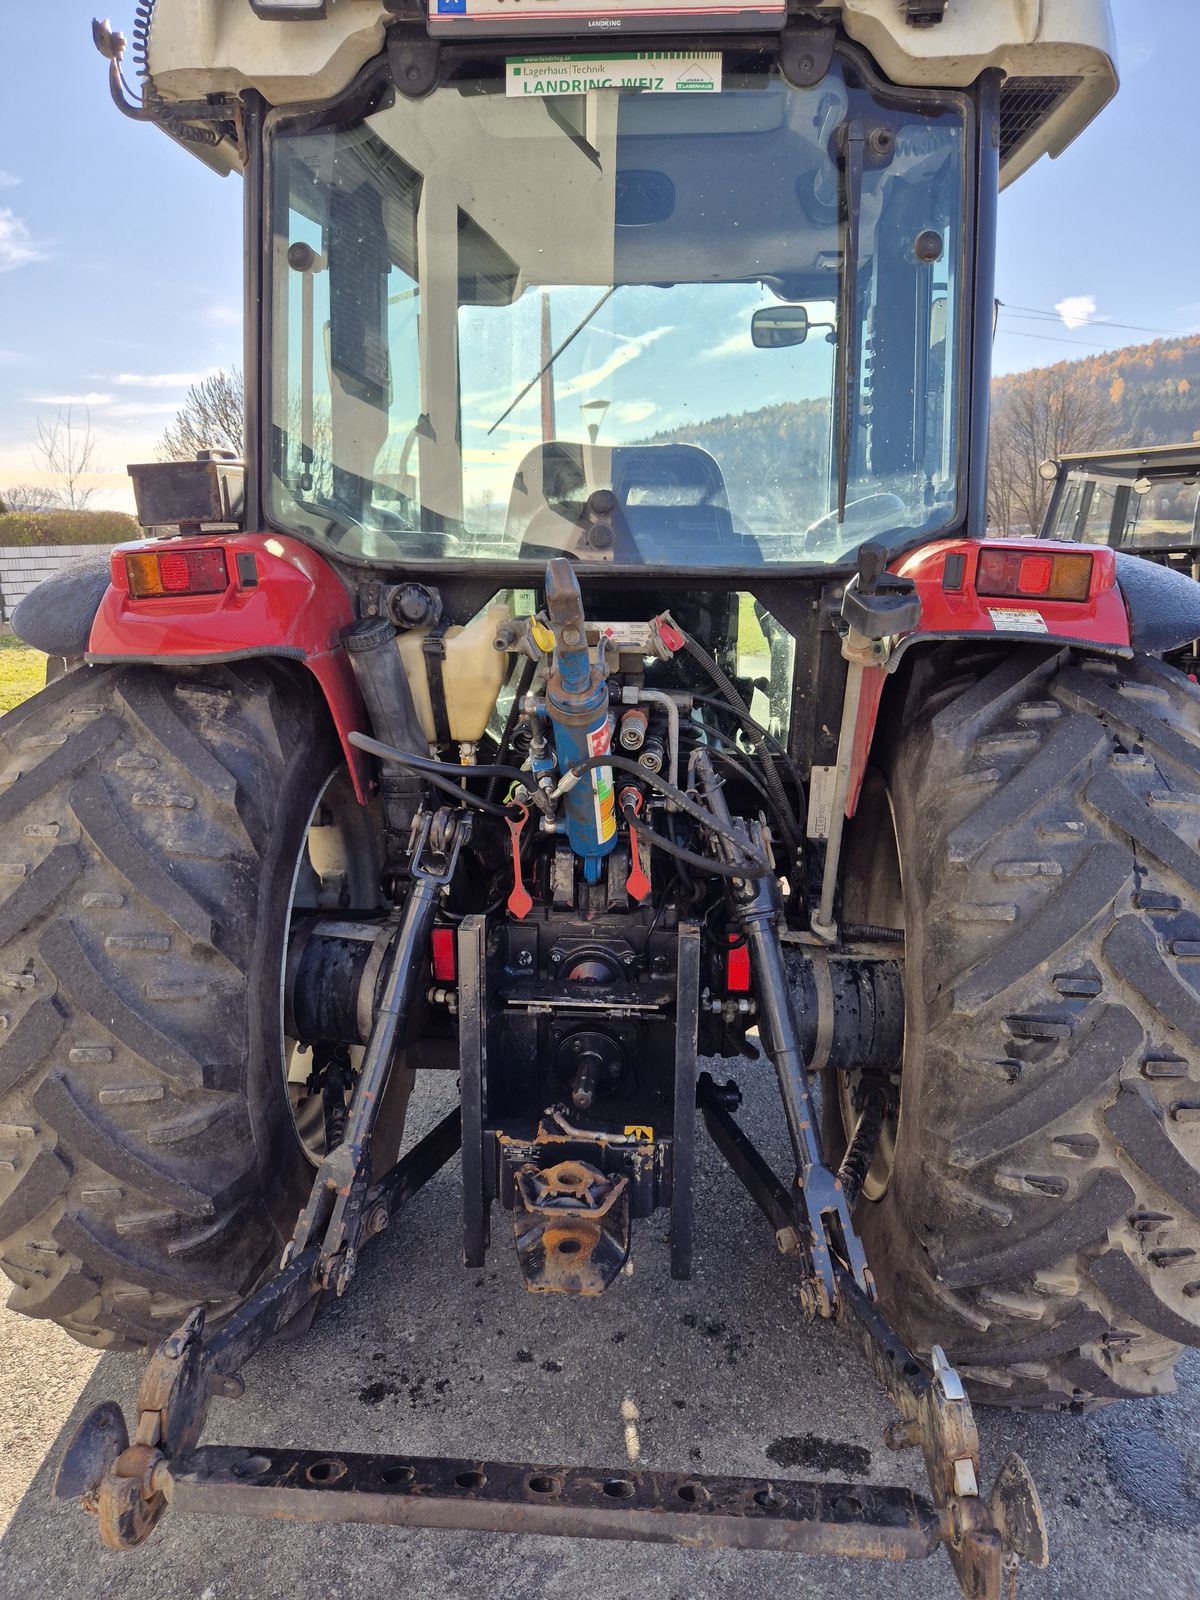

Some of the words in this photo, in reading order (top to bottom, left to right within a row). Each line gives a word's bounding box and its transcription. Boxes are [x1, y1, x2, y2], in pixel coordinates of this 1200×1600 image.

[523, 66, 568, 77] Lagerhaus
[572, 64, 606, 74] Technik
[523, 78, 613, 94] LANDRING
[621, 77, 664, 90] WEIZ
